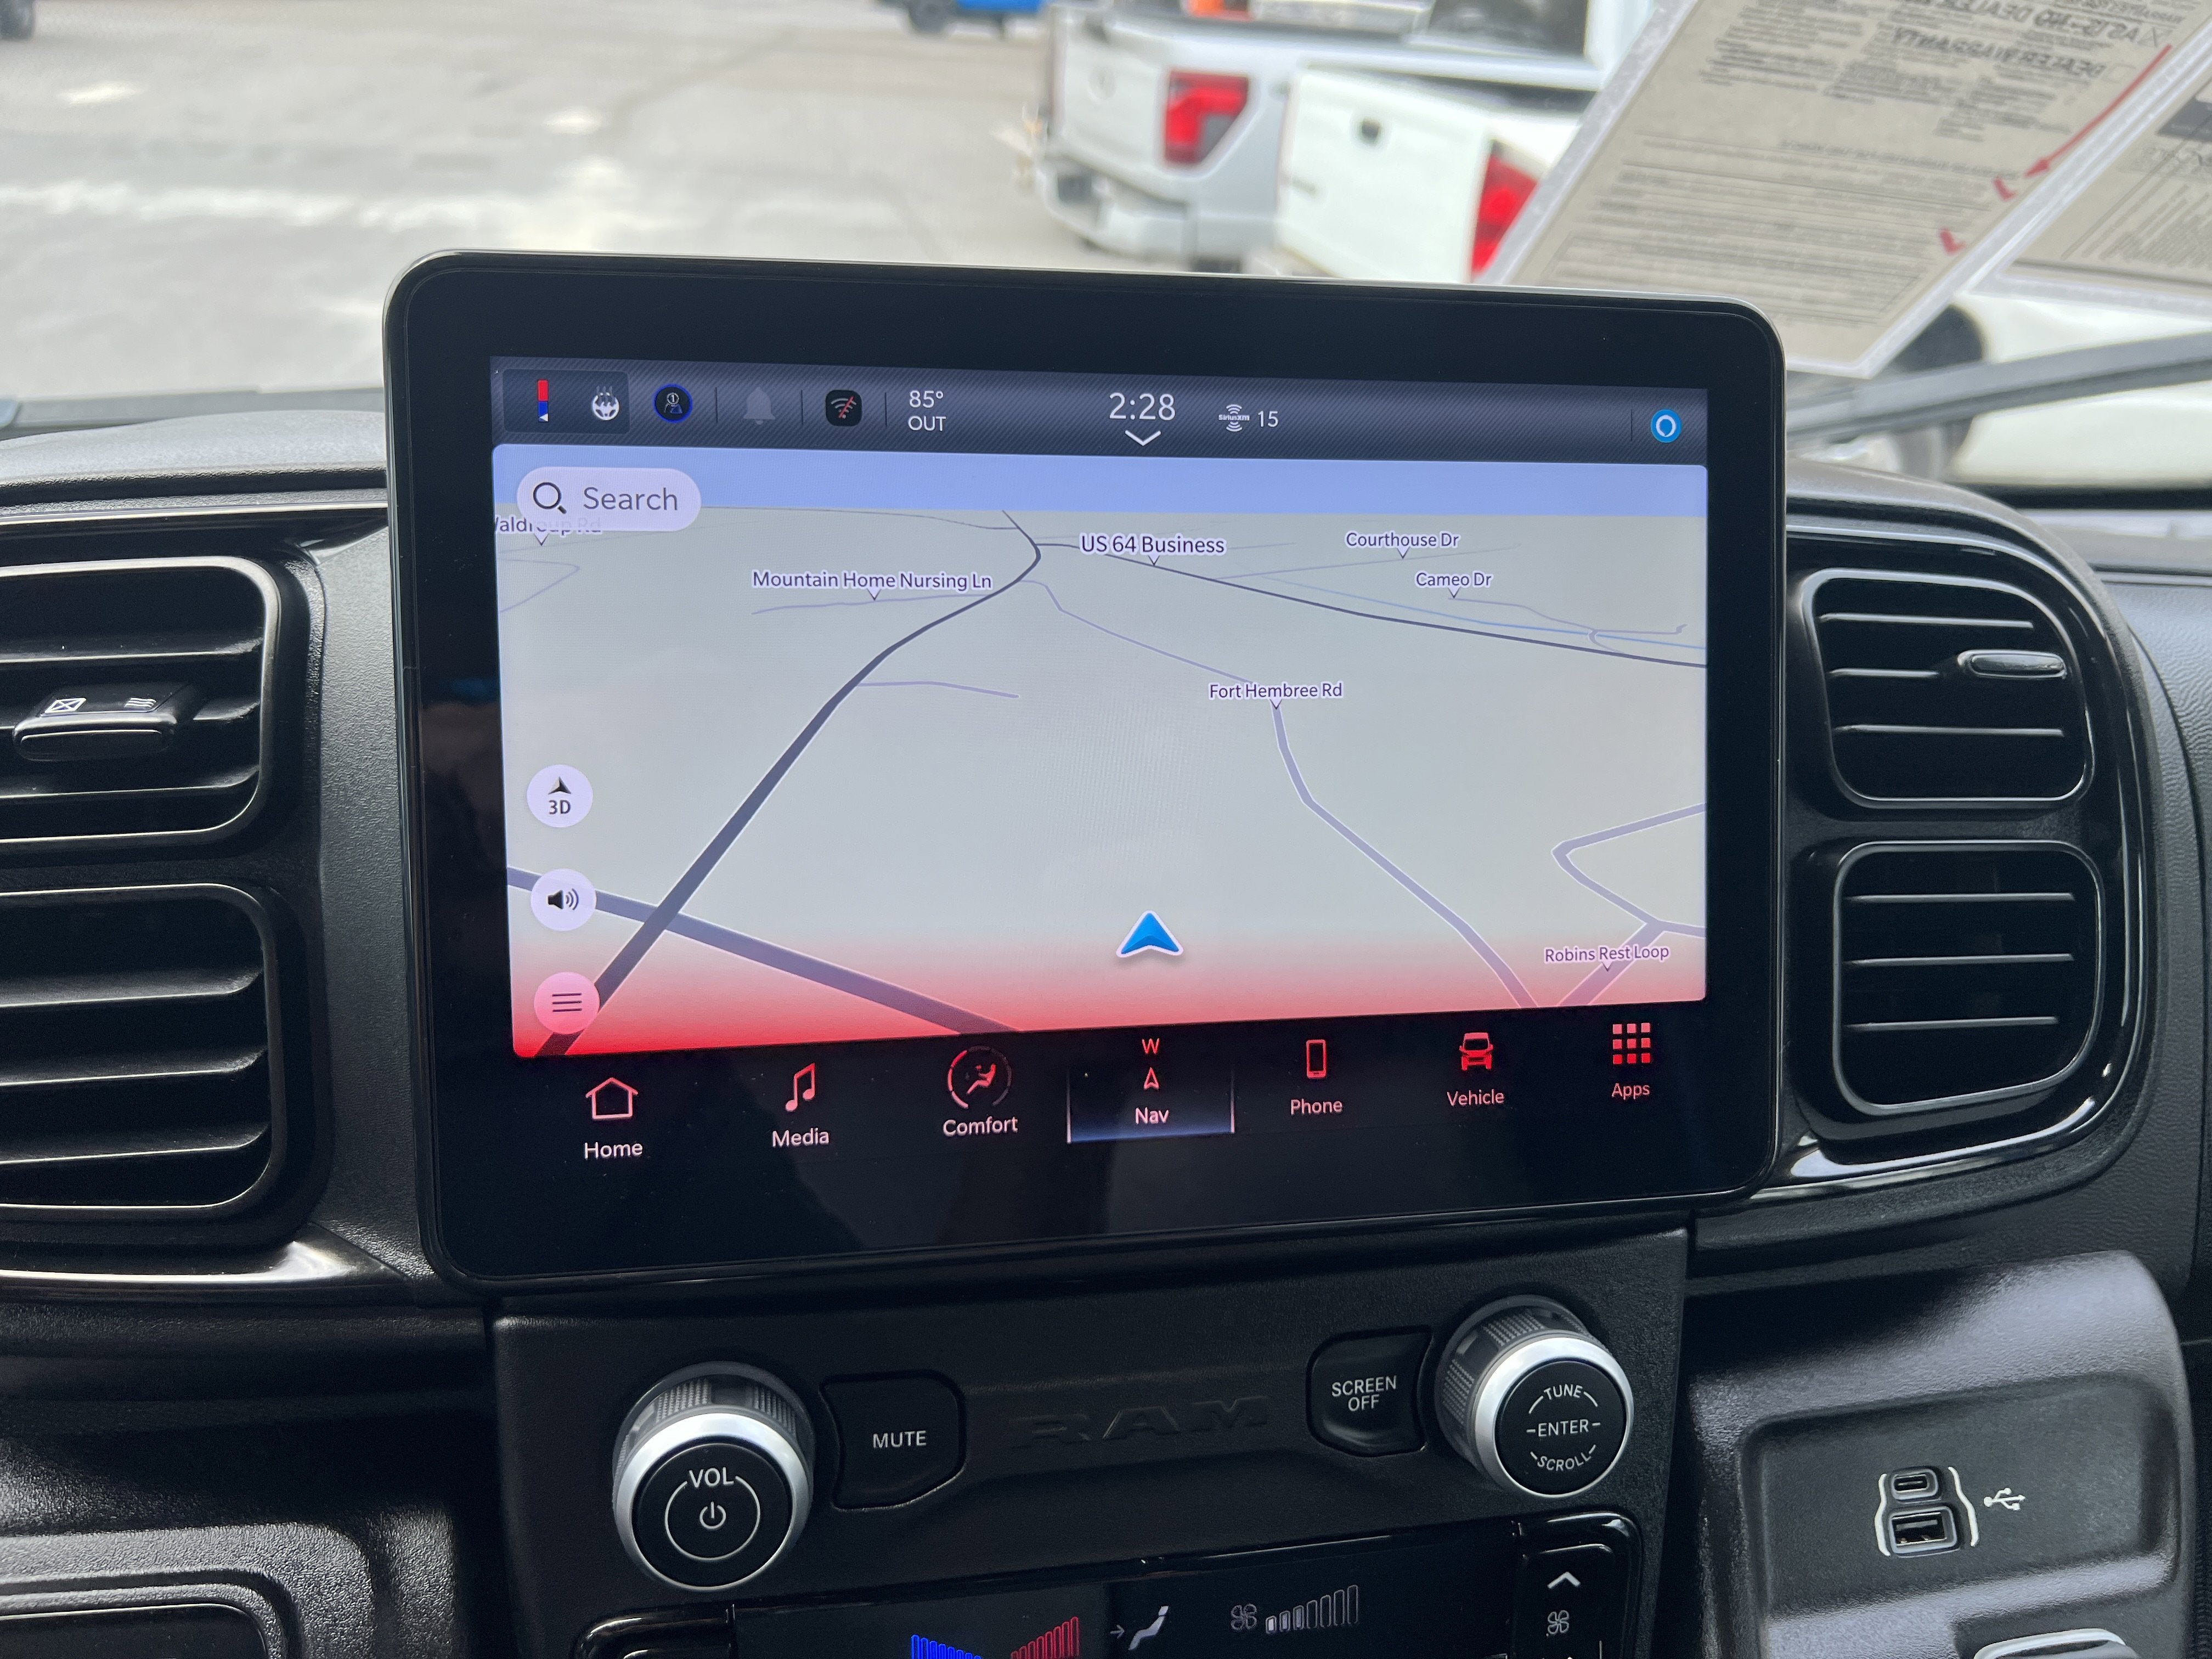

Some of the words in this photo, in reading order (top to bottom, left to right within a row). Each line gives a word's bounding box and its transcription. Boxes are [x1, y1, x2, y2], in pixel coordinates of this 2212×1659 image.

[909, 390, 944, 408] 85°
[1109, 392, 1176, 421] 2:28
[908, 415, 946, 431] OUT
[1257, 410, 1279, 427] 15
[583, 486, 679, 511] Search
[1081, 535, 1108, 552] US
[1112, 536, 1136, 552] 64
[1142, 535, 1225, 553] Business
[1346, 532, 1437, 547] Courthouse
[1441, 533, 1459, 547] Dr
[753, 572, 838, 588] Mountain
[844, 573, 896, 588] Home
[900, 573, 967, 591] Nursing
[973, 574, 992, 589] Ln
[1415, 572, 1470, 586] Cameo
[1474, 572, 1492, 586] Dr
[1210, 684, 1242, 698] Fort
[1245, 683, 1318, 698] Hembree
[1322, 682, 1342, 697] Rd
[549, 799, 571, 815] 3D
[1545, 947, 1595, 962] Robins
[1599, 946, 1630, 960] Rest
[1634, 946, 1669, 961] Loop
[1141, 1037, 1160, 1054] W
[1446, 1088, 1505, 1107] Vehicle
[1611, 1082, 1650, 1101] Apps
[1135, 1106, 1170, 1125] Nav
[1290, 1098, 1343, 1115] Phone
[943, 1115, 1018, 1137] Comfort
[771, 1127, 830, 1148] Media
[584, 1141, 644, 1160] Home
[1331, 1375, 1397, 1398] SCREEN
[1543, 1384, 1583, 1401] TUNE
[1347, 1394, 1380, 1412] OFF
[1538, 1419, 1589, 1438] ENTER
[873, 1430, 927, 1449] MUTE
[1537, 1452, 1592, 1472] SCROLL
[689, 1467, 734, 1488] VOL
